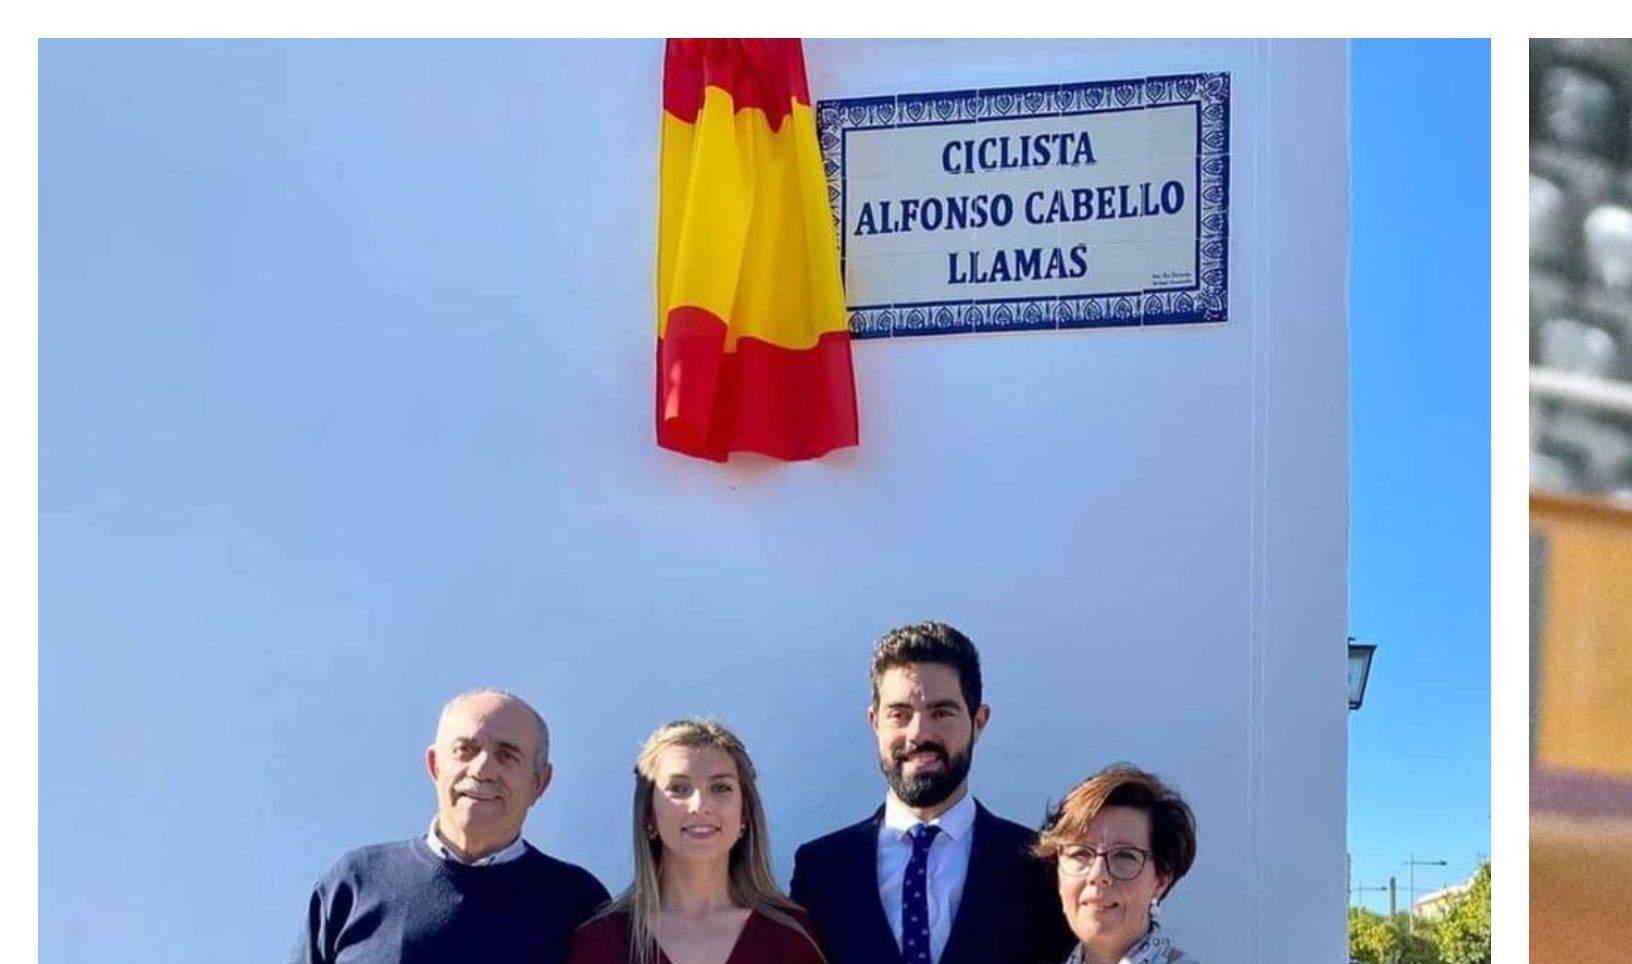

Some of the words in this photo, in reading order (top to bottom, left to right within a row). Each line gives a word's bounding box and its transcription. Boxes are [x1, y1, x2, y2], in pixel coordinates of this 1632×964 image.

[942, 131, 1097, 174] CICLISTA
[853, 193, 1014, 236] ALFONSO
[1025, 180, 1185, 225] CABELLO
[947, 244, 1088, 284] LLAMAS
